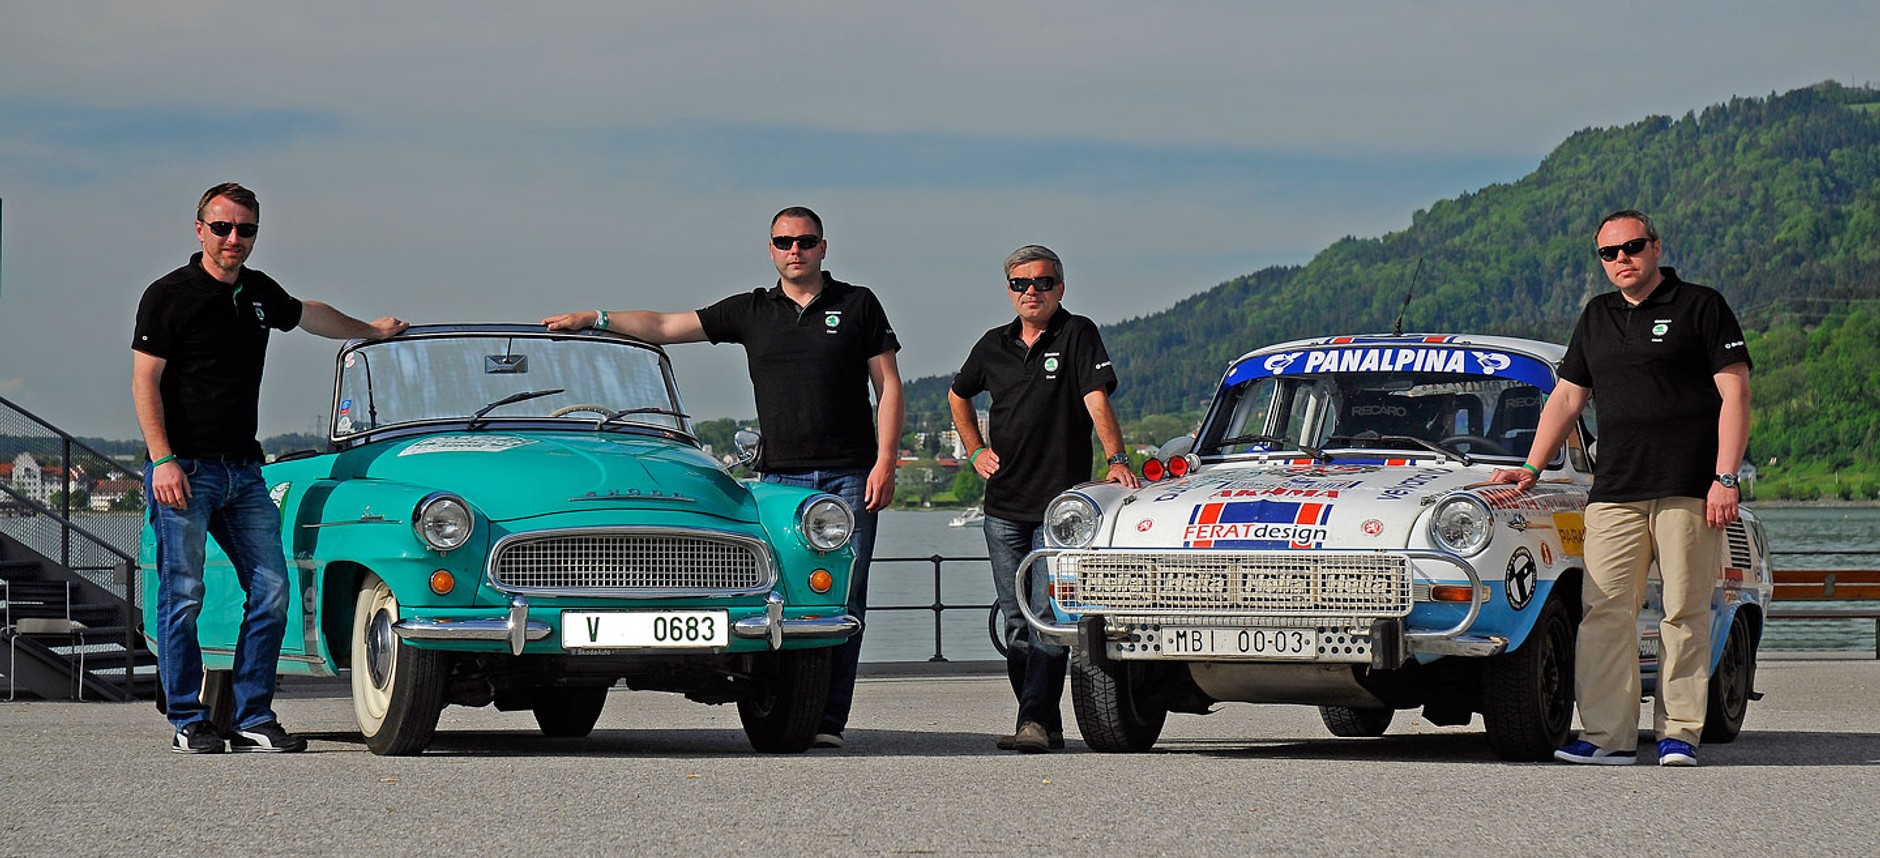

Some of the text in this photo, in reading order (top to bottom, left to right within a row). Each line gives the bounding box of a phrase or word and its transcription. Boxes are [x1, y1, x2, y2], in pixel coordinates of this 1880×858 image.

[1303, 348, 1465, 374] PANALPINA
[1351, 402, 1407, 418] RECARO
[1184, 524, 1327, 545] FERATdesign
[587, 616, 715, 642] V 0683
[1237, 632, 1304, 653] 00-03
